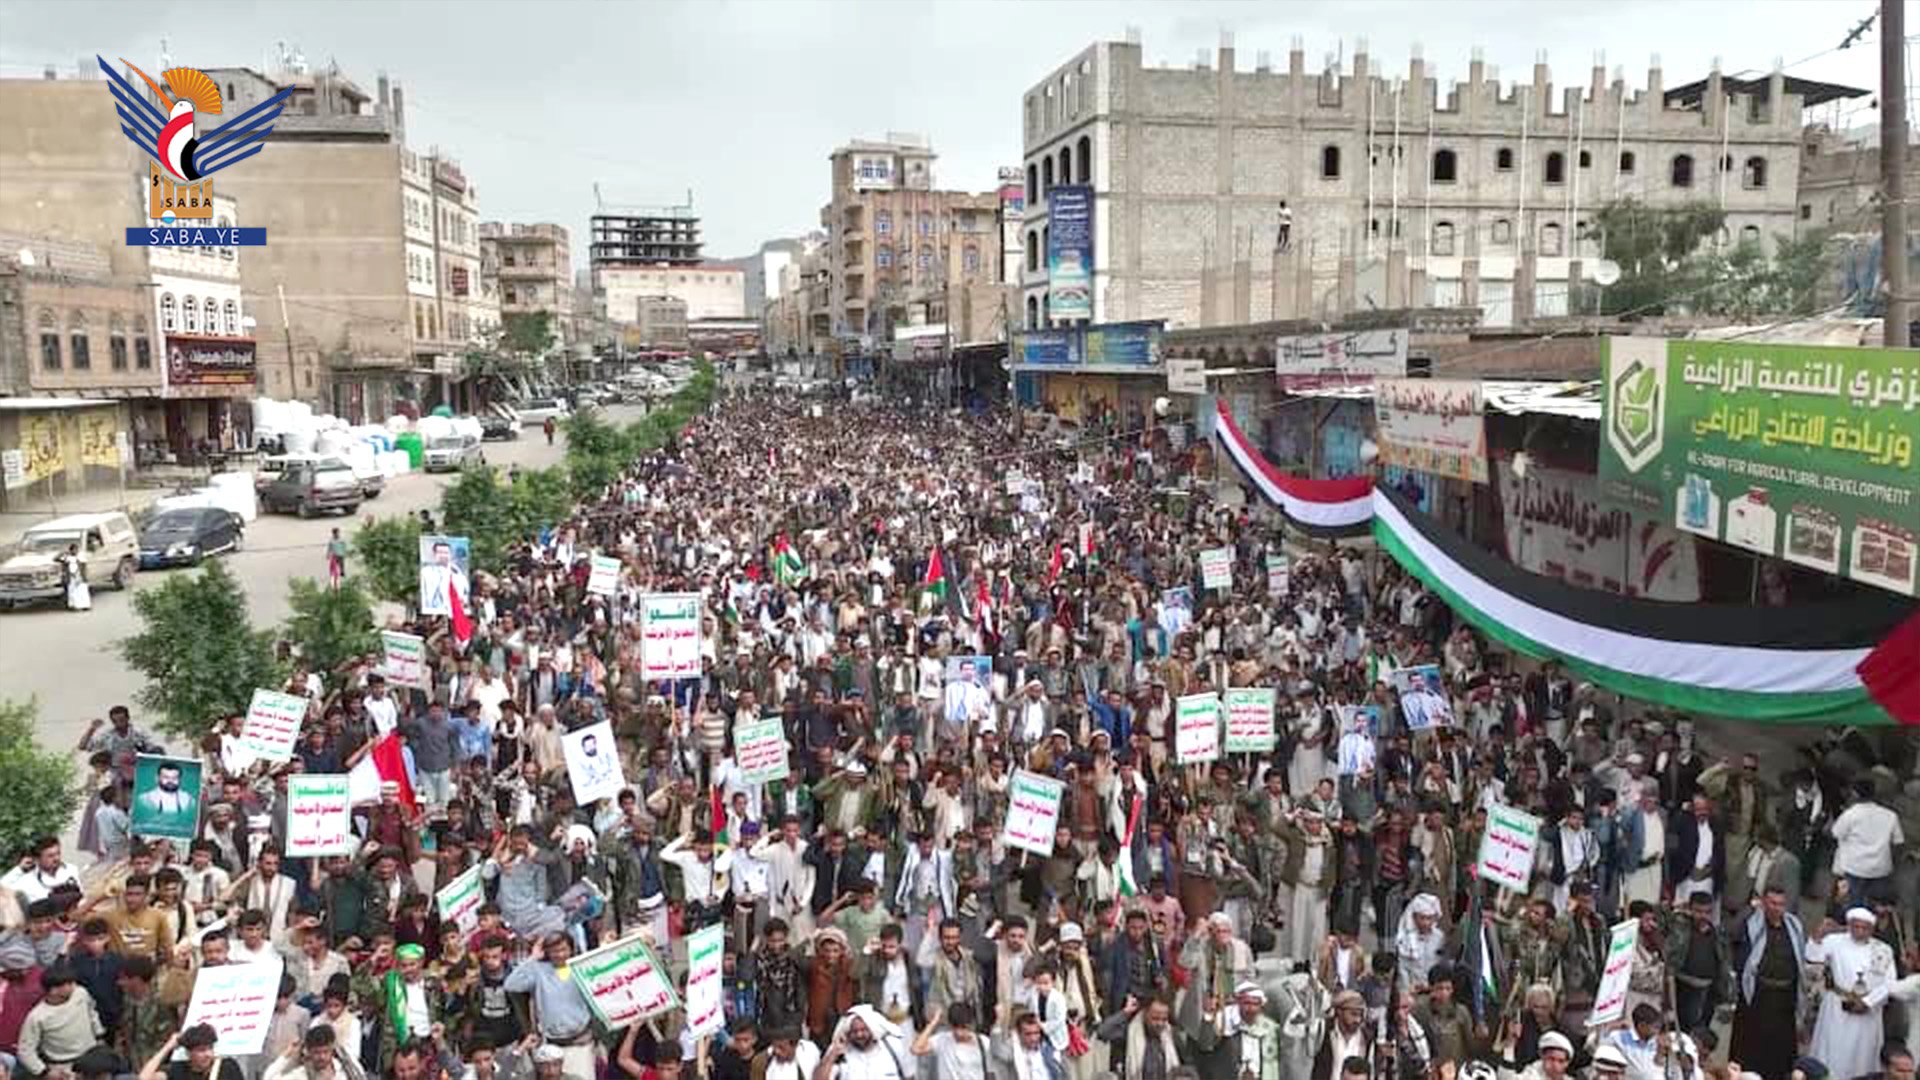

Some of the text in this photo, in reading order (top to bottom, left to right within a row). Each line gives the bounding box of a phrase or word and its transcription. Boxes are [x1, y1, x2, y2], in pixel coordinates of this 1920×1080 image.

[1683, 354, 1754, 395] الزراعية
[1757, 359, 1843, 399] للتنمية
[1692, 404, 1760, 442] الزراعي
[1830, 416, 1912, 469] وزيادة
[1728, 458, 1747, 474] FOR
[1748, 461, 1822, 490] AGRICULTURAL
[1823, 476, 1912, 505] DEVELOPMENT
